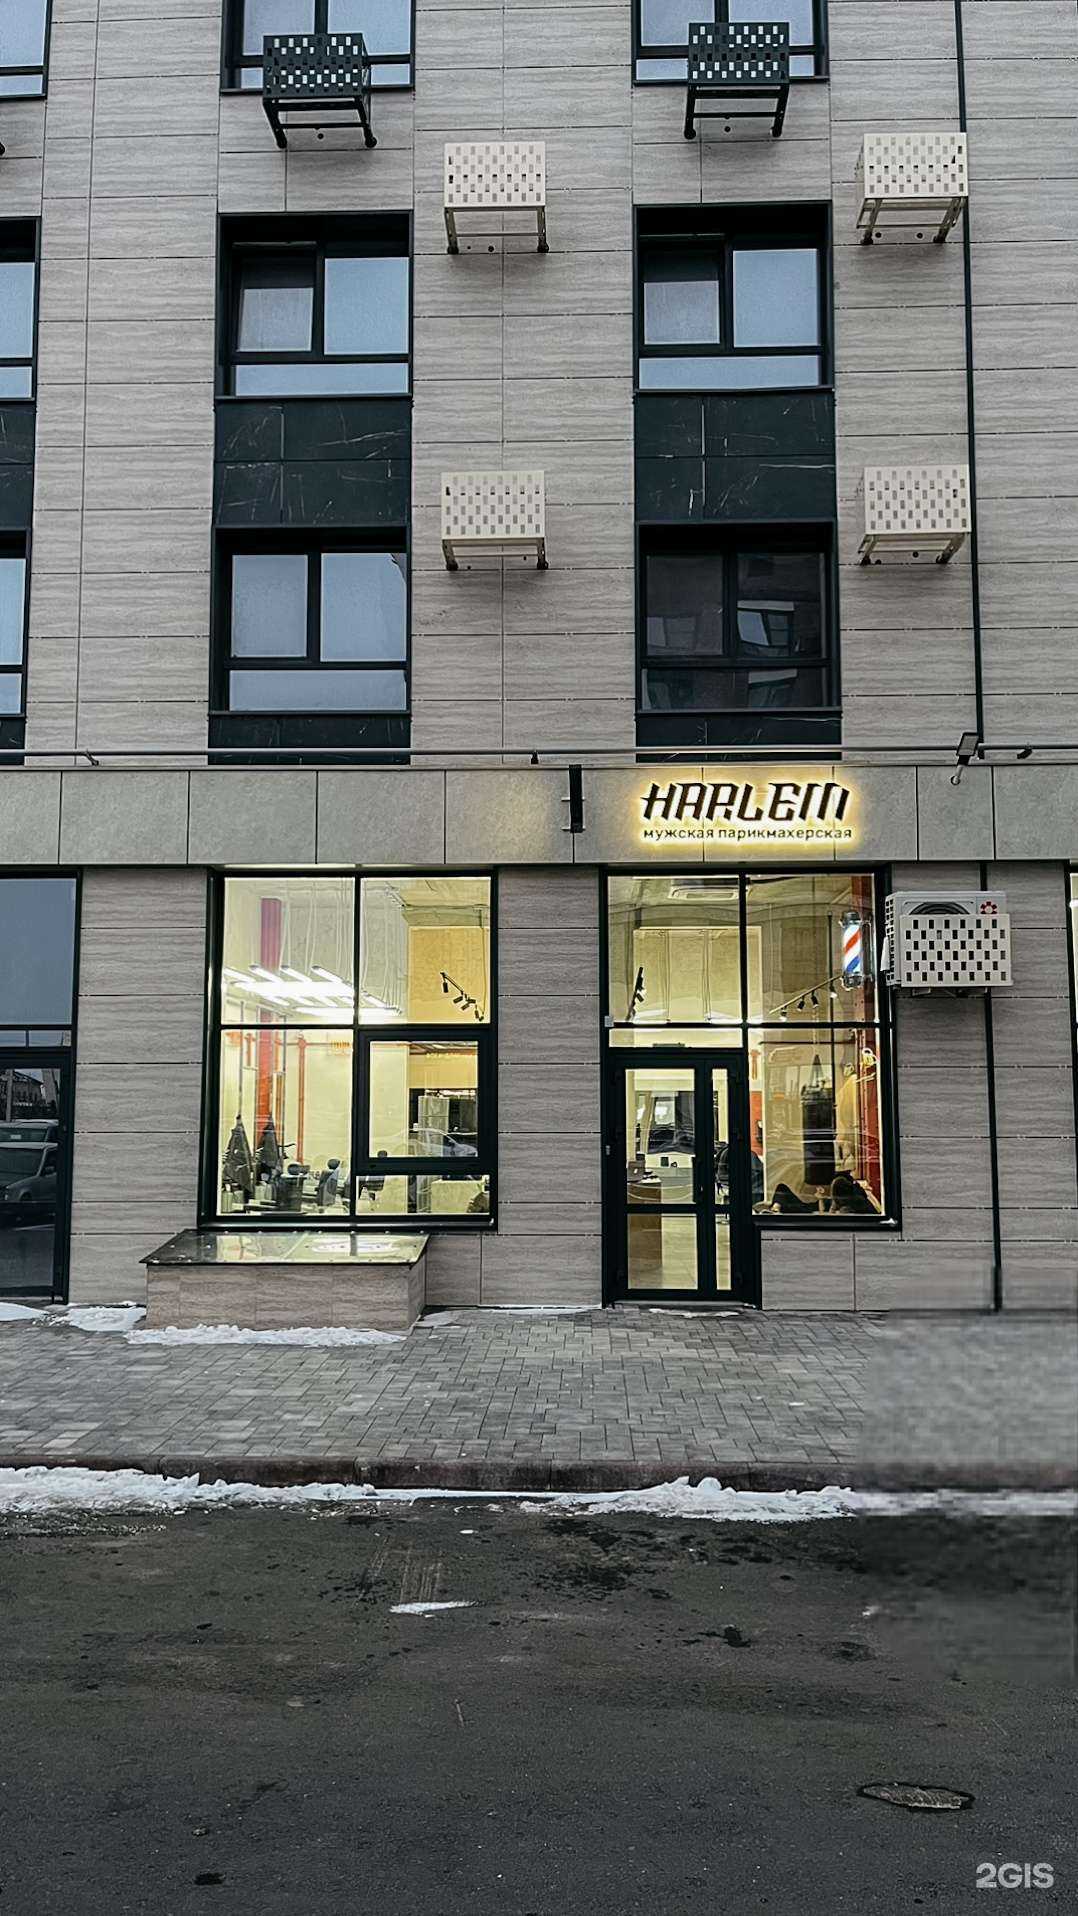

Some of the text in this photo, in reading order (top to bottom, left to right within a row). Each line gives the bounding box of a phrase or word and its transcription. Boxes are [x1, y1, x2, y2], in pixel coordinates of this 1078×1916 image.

[641, 782, 850, 821] HARLEM
[643, 828, 852, 841] мужская парикмахерская
